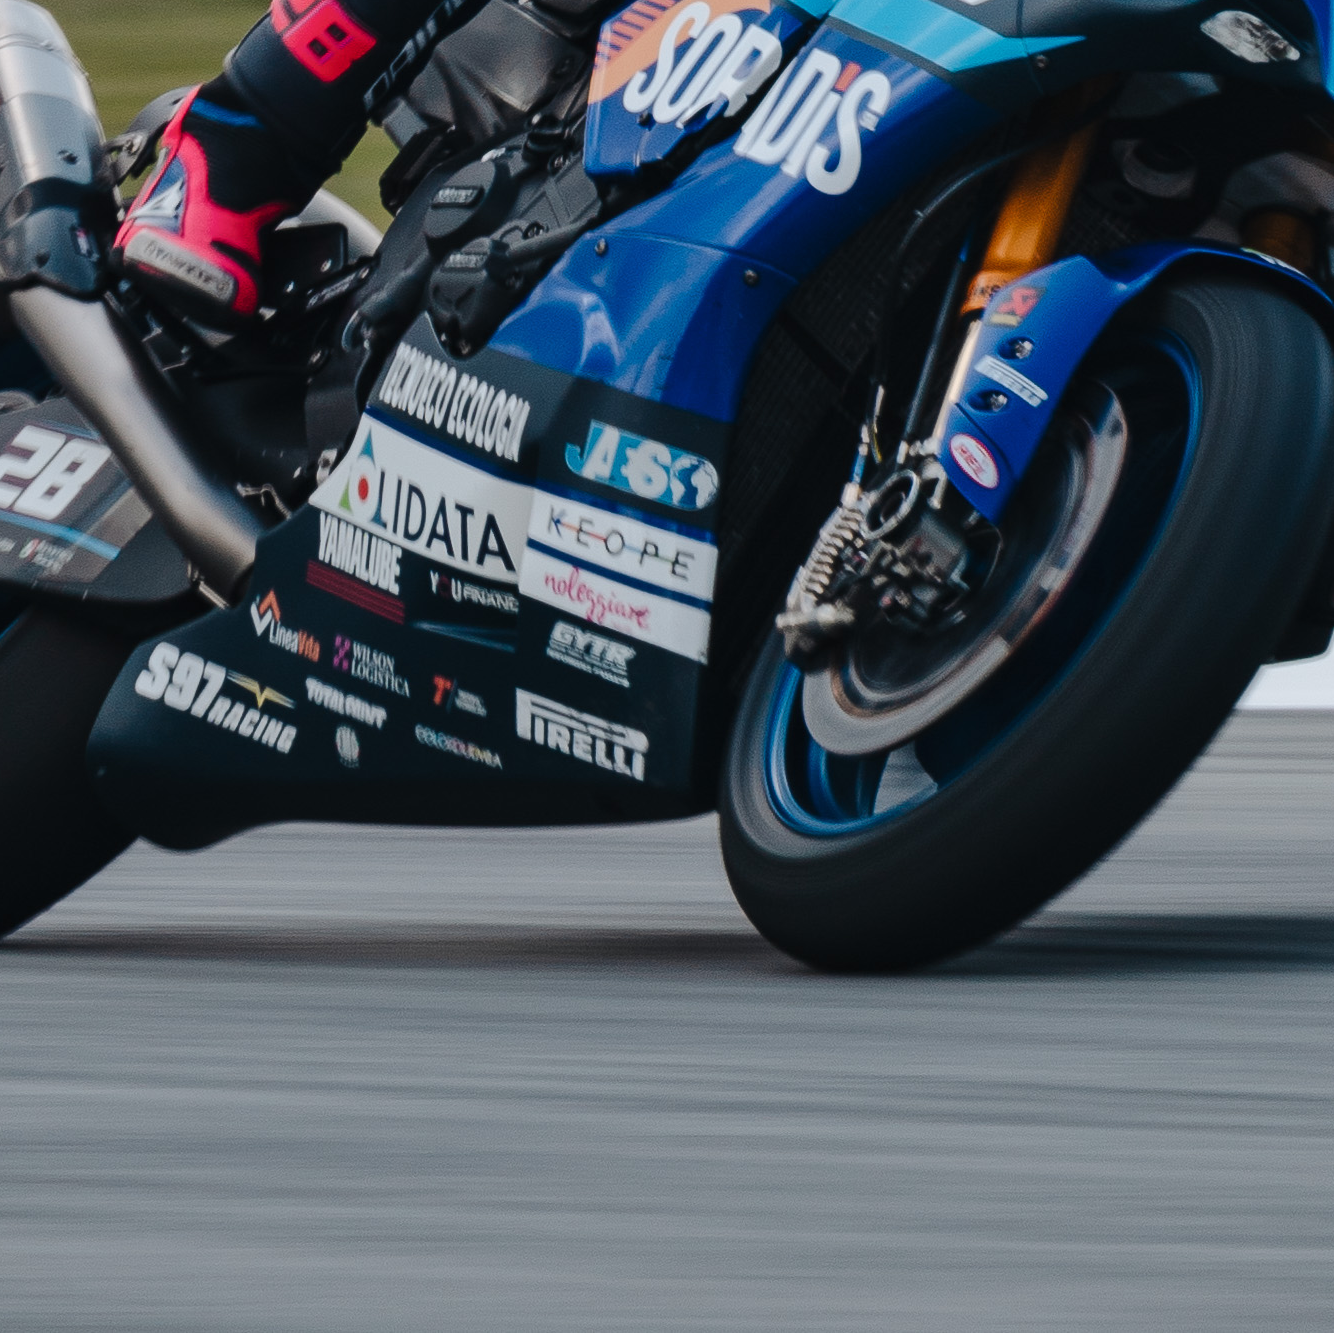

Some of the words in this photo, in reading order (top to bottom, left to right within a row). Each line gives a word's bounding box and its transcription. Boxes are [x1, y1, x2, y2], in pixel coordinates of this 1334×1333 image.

[318, 510, 404, 597] YAMALUBE
[537, 505, 695, 583] KEOPE
[134, 641, 228, 720] S97
[206, 694, 298, 755] RACING
[351, 658, 411, 699] LOGISTICA
[352, 639, 395, 675] WILSON
[515, 686, 650, 782] PIRELLI
